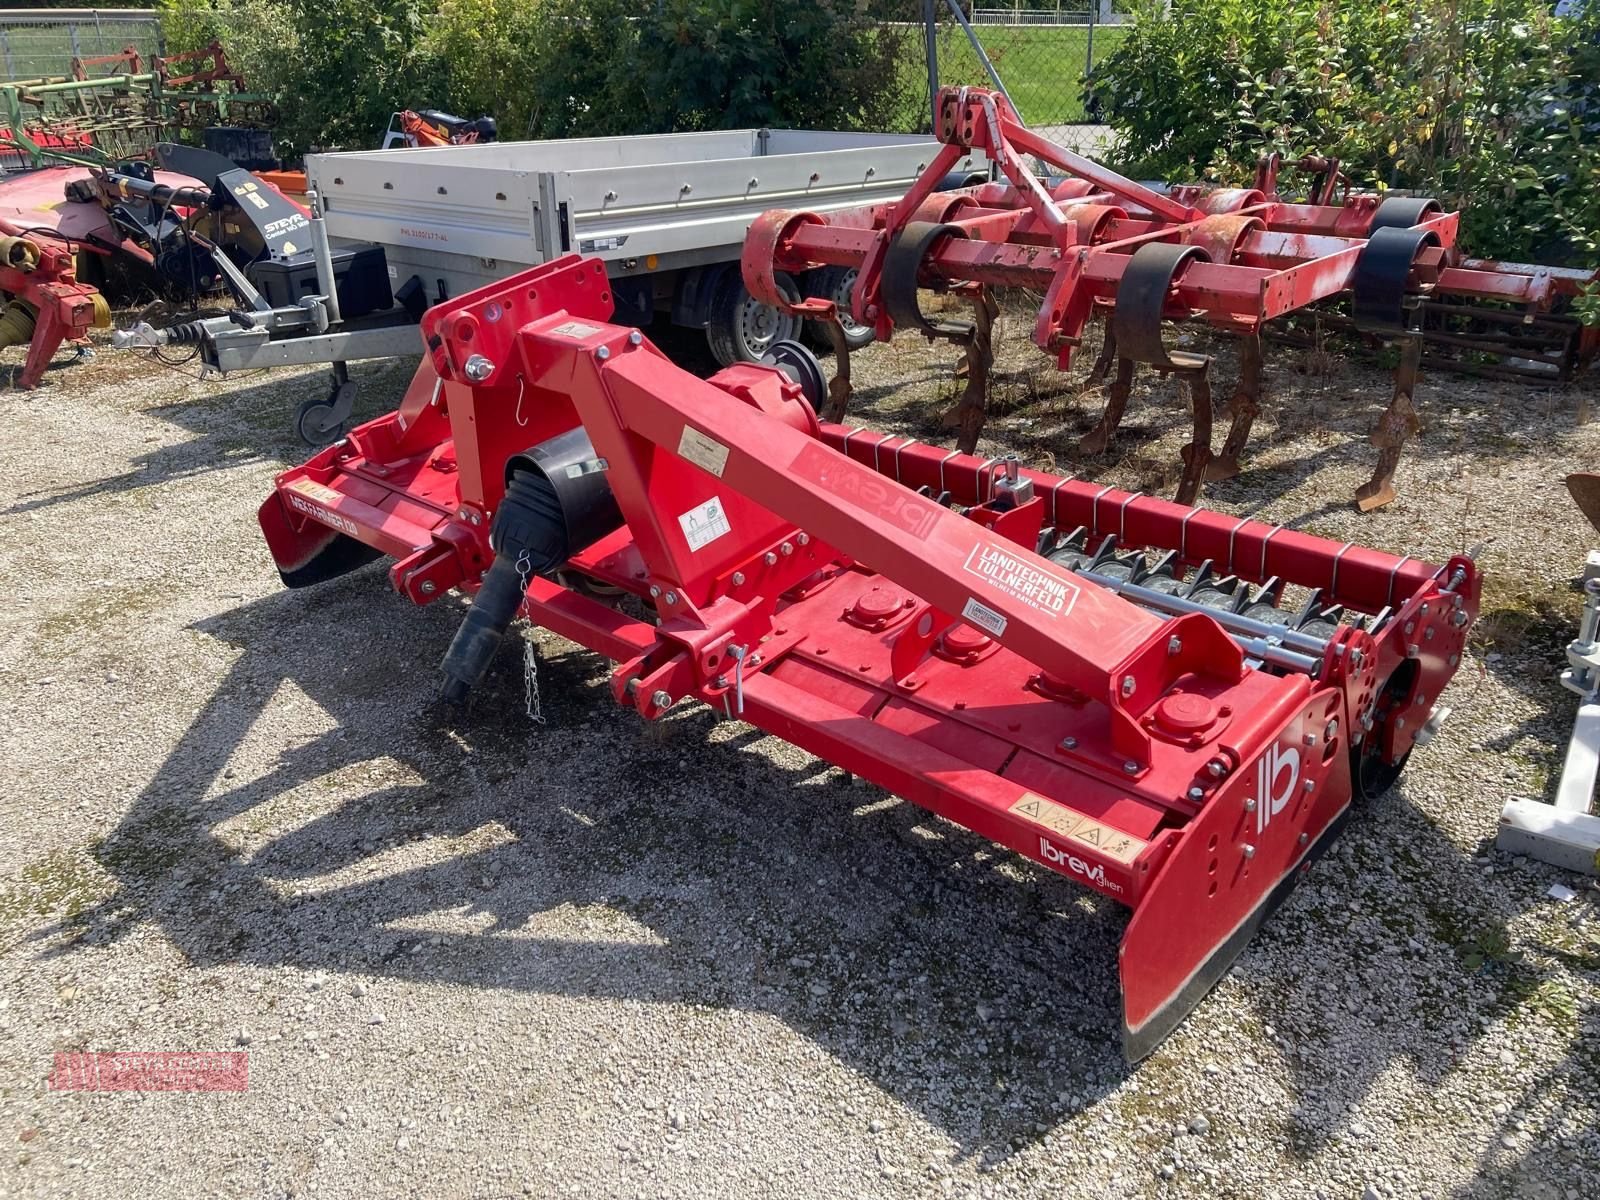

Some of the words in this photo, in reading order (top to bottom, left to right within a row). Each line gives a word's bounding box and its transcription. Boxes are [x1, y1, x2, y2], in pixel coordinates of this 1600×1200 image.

[264, 213, 304, 233] STEYR
[977, 557, 1065, 612] TULLNERFELD
[980, 546, 1070, 600] LANDTECHNIK
